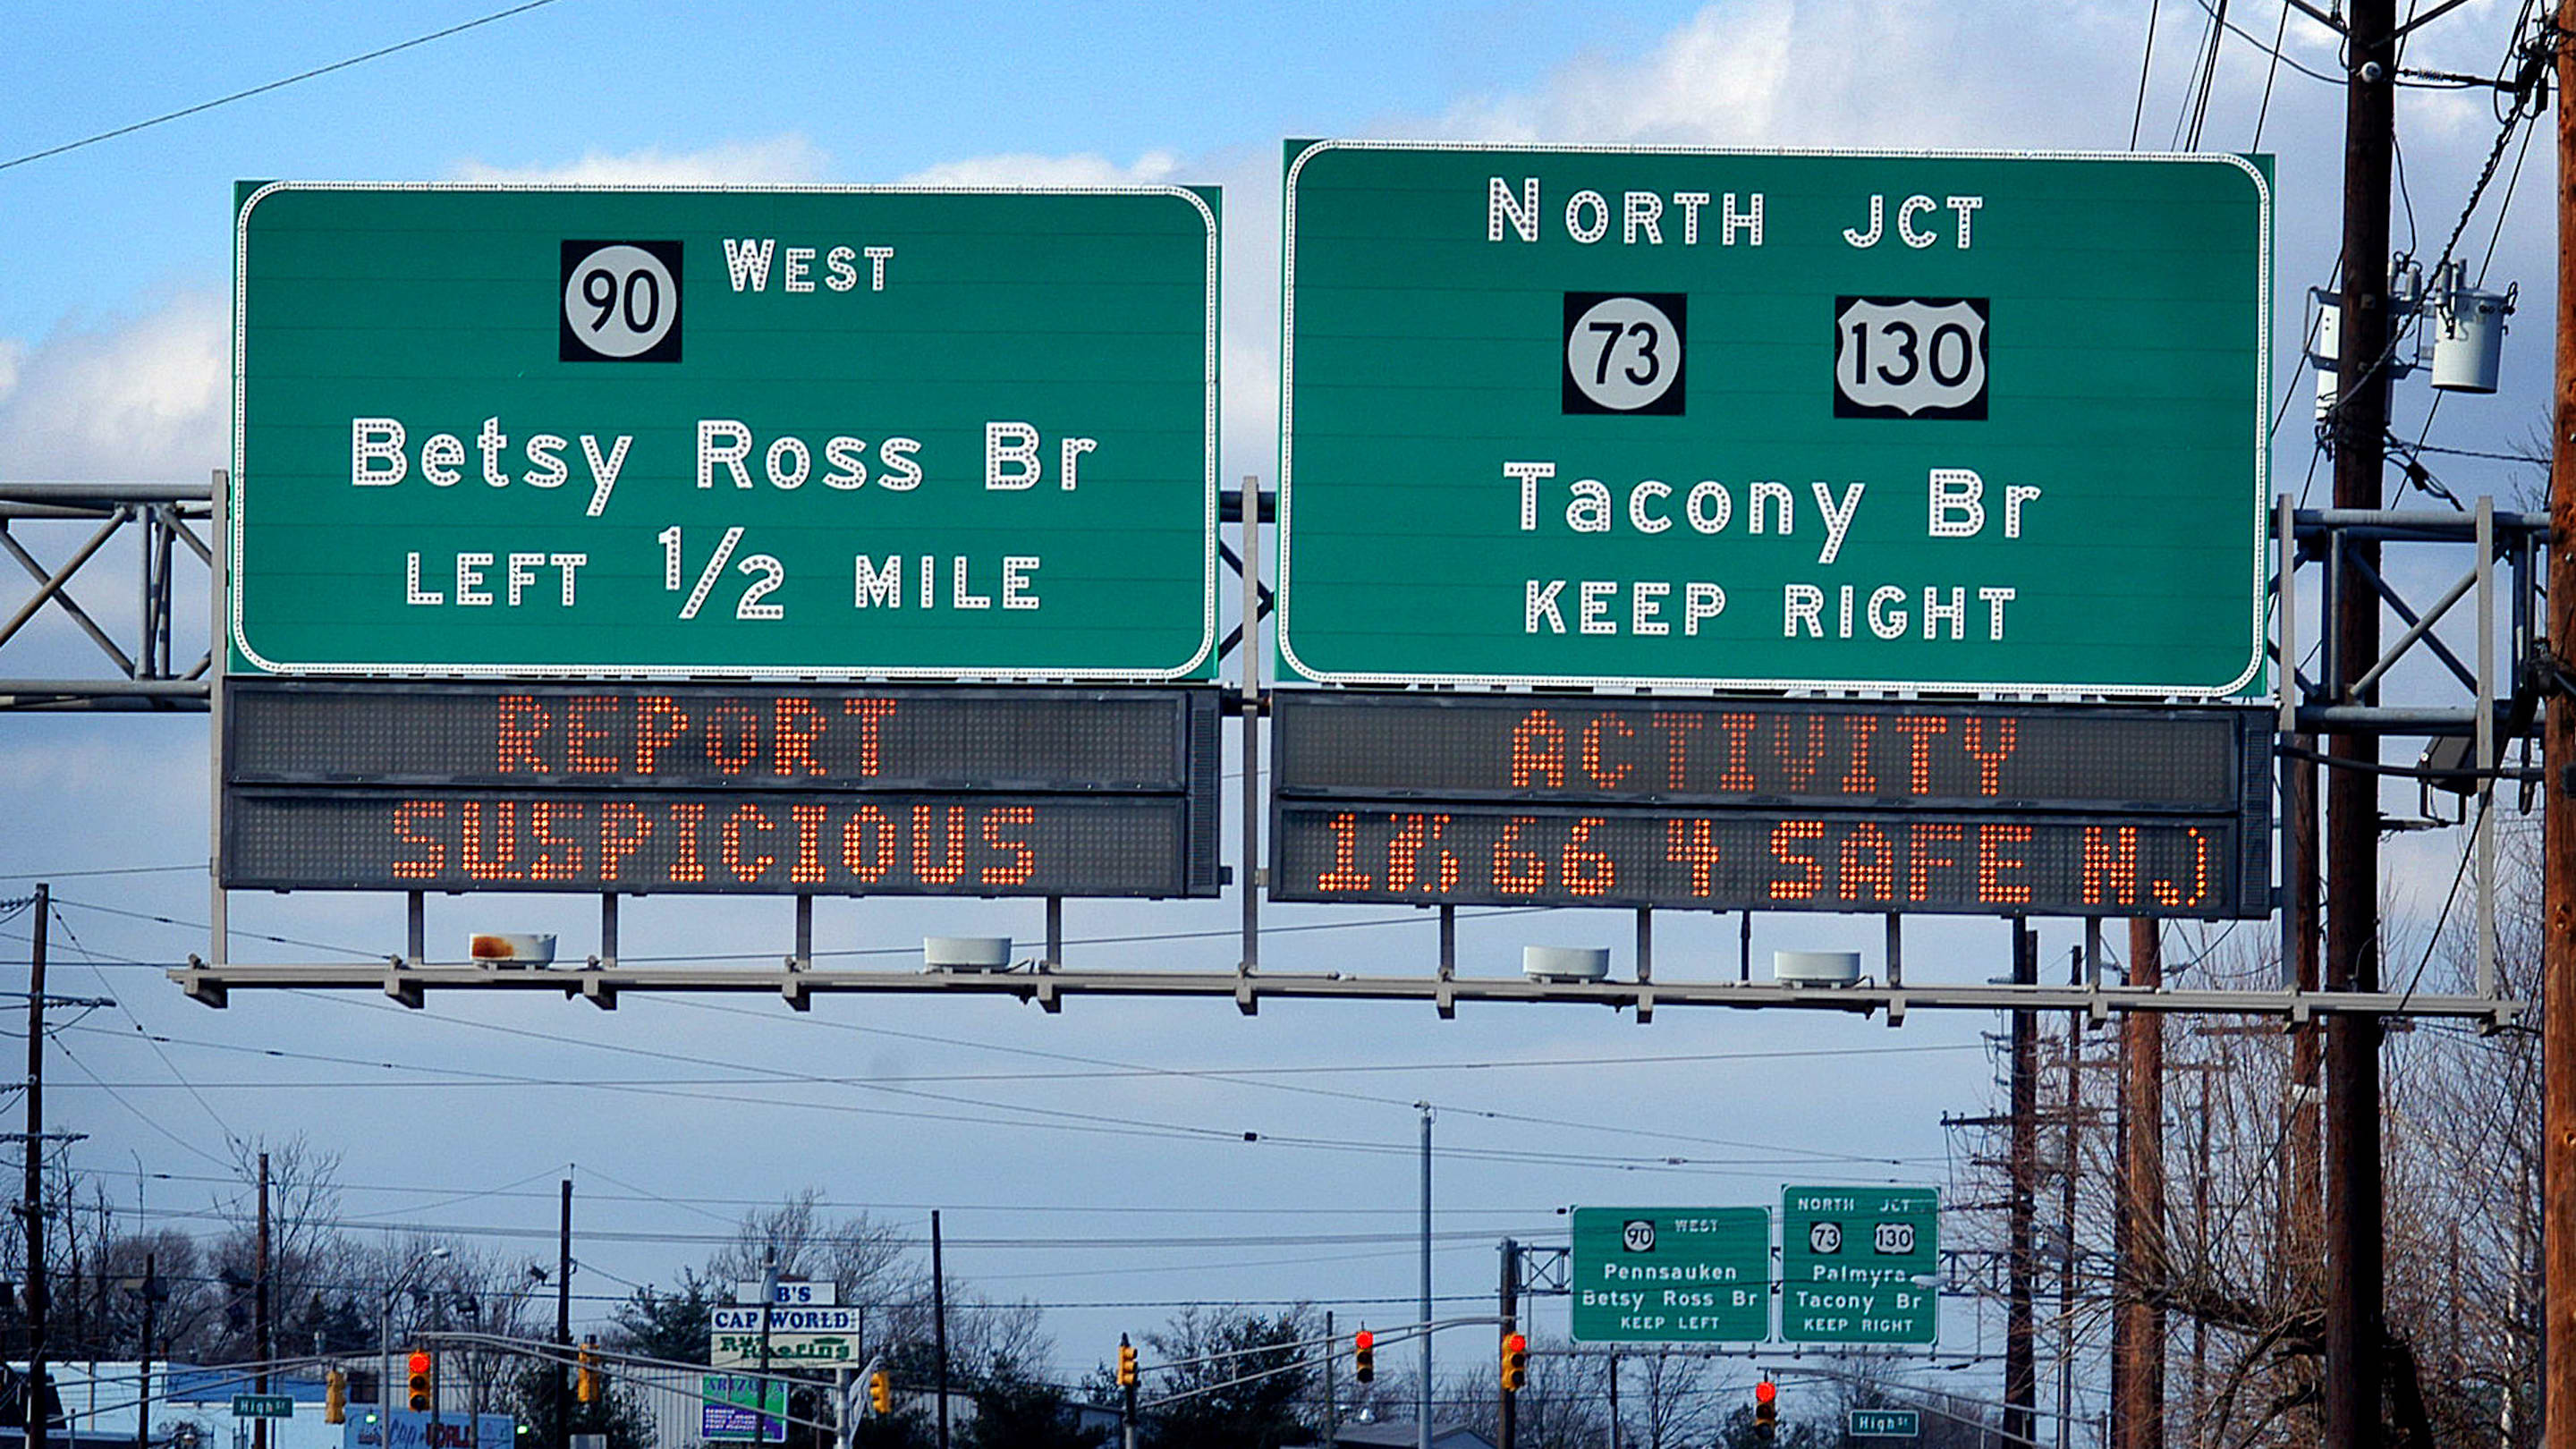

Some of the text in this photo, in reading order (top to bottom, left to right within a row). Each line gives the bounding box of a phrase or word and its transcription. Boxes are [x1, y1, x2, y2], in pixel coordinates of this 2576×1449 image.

[1487, 177, 1983, 250] NORTH JCT
[723, 238, 894, 294] WEST
[582, 267, 661, 334] 90
[1588, 322, 1659, 386] 73
[1851, 322, 1971, 388] 130
[352, 417, 1098, 517] Betsy Ross Br
[1503, 462, 2042, 564] Tacony Br
[407, 526, 1040, 620] LEFT 1/2 MILE
[1524, 580, 2016, 641] KEEP RIGHT
[497, 695, 896, 776] REPORT
[1513, 708, 2016, 795] ACTIVITY
[393, 800, 1036, 885] SUSPICIOUS
[1770, 820, 2032, 903] SAFE
[1798, 1198, 1911, 1212] NORTH JCT
[1626, 1228, 1652, 1245] 90
[1674, 1219, 1719, 1233] WEST
[1815, 1229, 1838, 1247] 73
[1879, 1229, 1911, 1247] 130
[1604, 1263, 1737, 1280] Pennsauken
[1813, 1265, 1906, 1289] Palmyra
[1582, 1290, 1758, 1312] Betsy Ross Br
[1796, 1291, 1921, 1316] Tacony Br
[716, 1311, 758, 1328] CAP
[770, 1311, 849, 1328] WORLD
[1621, 1316, 1719, 1329] KEEP LEFT
[1804, 1318, 1913, 1332] KEEP RIGHT
[241, 1400, 273, 1414] High
[1860, 1415, 1895, 1432] High
